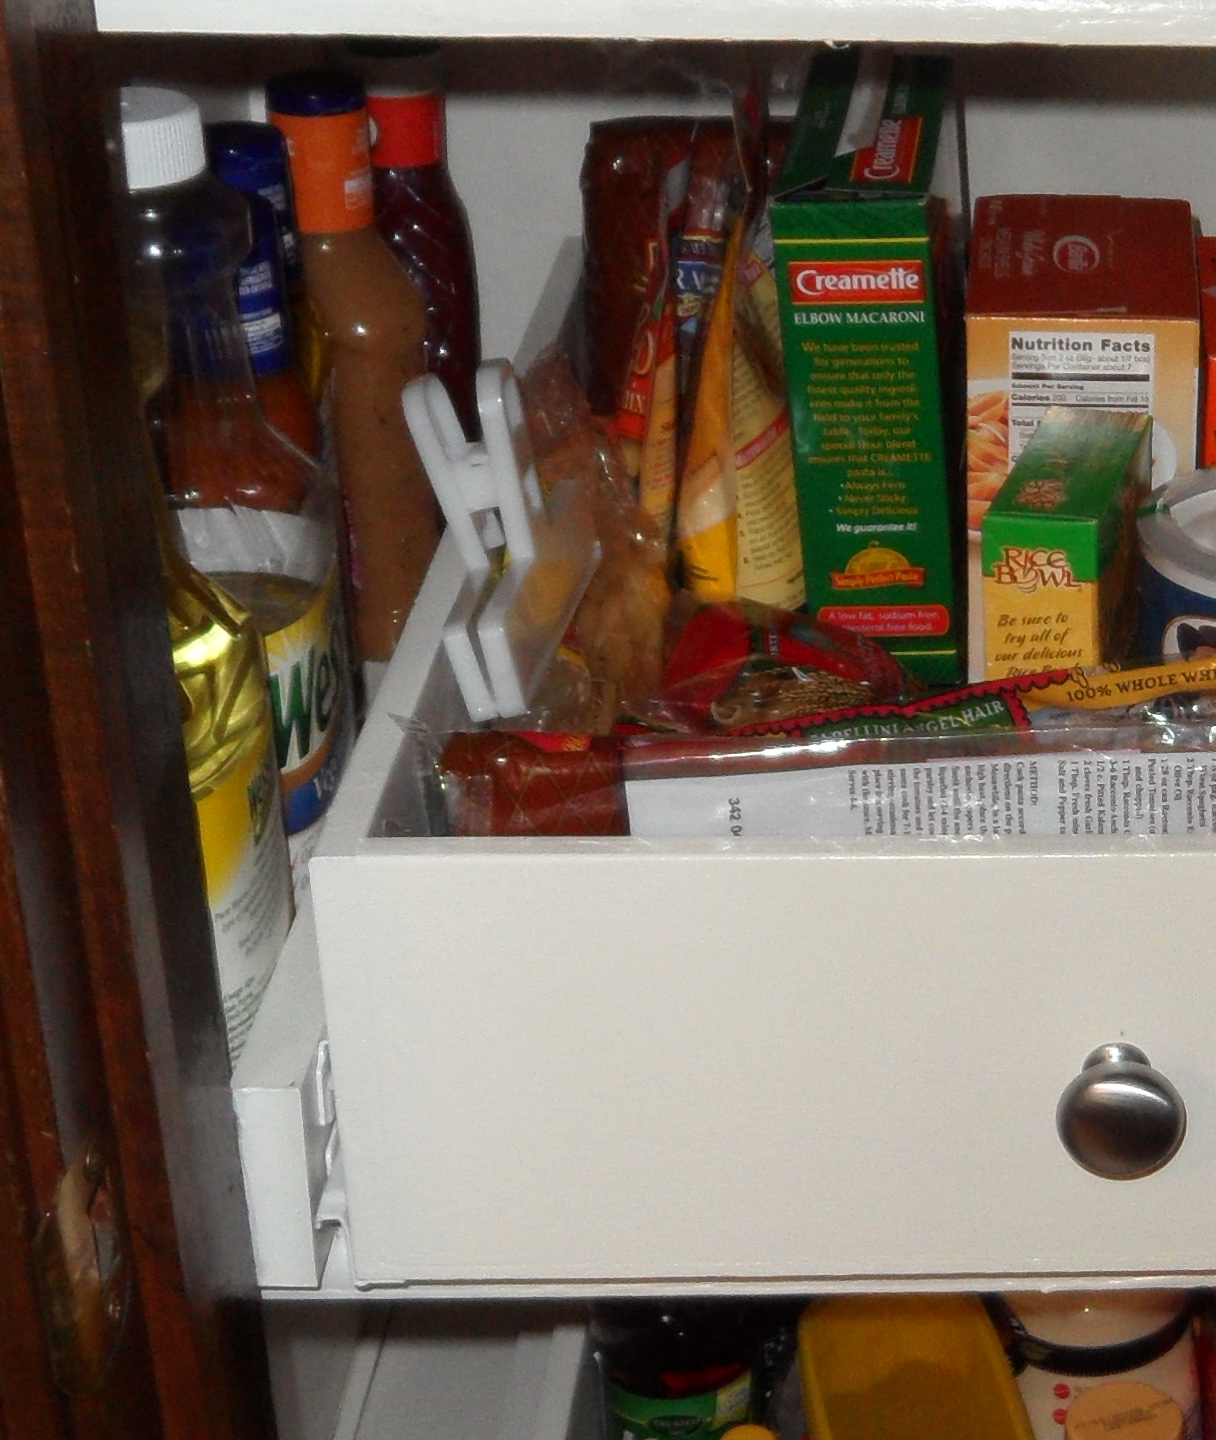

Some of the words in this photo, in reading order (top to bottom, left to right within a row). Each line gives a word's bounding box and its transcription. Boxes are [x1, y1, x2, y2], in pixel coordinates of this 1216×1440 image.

[863, 120, 902, 180] Creamette
[796, 267, 920, 296] Creamette
[794, 311, 842, 325] ELBOW
[846, 310, 926, 325] MACARONI
[802, 342, 820, 352] We
[823, 342, 849, 352] have
[852, 342, 878, 352] been
[880, 342, 919, 352] trusted
[1011, 337, 1093, 352] Nutrition
[1100, 338, 1151, 353] Facts
[872, 372, 895, 383] only
[840, 385, 876, 397] quality
[834, 400, 864, 409] make
[1011, 394, 1050, 402] Calories
[1076, 395, 1105, 403] Calories
[853, 414, 877, 425] your
[879, 412, 919, 423] family's
[1011, 419, 1034, 428] Total
[886, 440, 917, 450] blend
[870, 453, 932, 464] CREAMETTE
[877, 493, 907, 505] Sticky
[872, 505, 918, 516] Delicious
[836, 522, 852, 532] We
[853, 522, 904, 535] guarantee
[1003, 547, 1067, 567] RICE
[994, 564, 1081, 589] BOWL
[838, 611, 856, 620] low
[878, 610, 917, 620] sodium
[997, 613, 1018, 627] Be
[1021, 614, 1051, 626] sure
[1055, 612, 1069, 624] to
[1004, 632, 1027, 647] try
[1031, 627, 1050, 643] all
[1052, 627, 1072, 644] of
[995, 652, 1020, 662] our
[1022, 647, 1084, 662] delicious
[1067, 684, 1112, 702] 100%
[1115, 672, 1177, 694] WHOLE
[268, 645, 337, 768] We
[961, 699, 1005, 723] HAIR
[728, 798, 742, 822] 342
